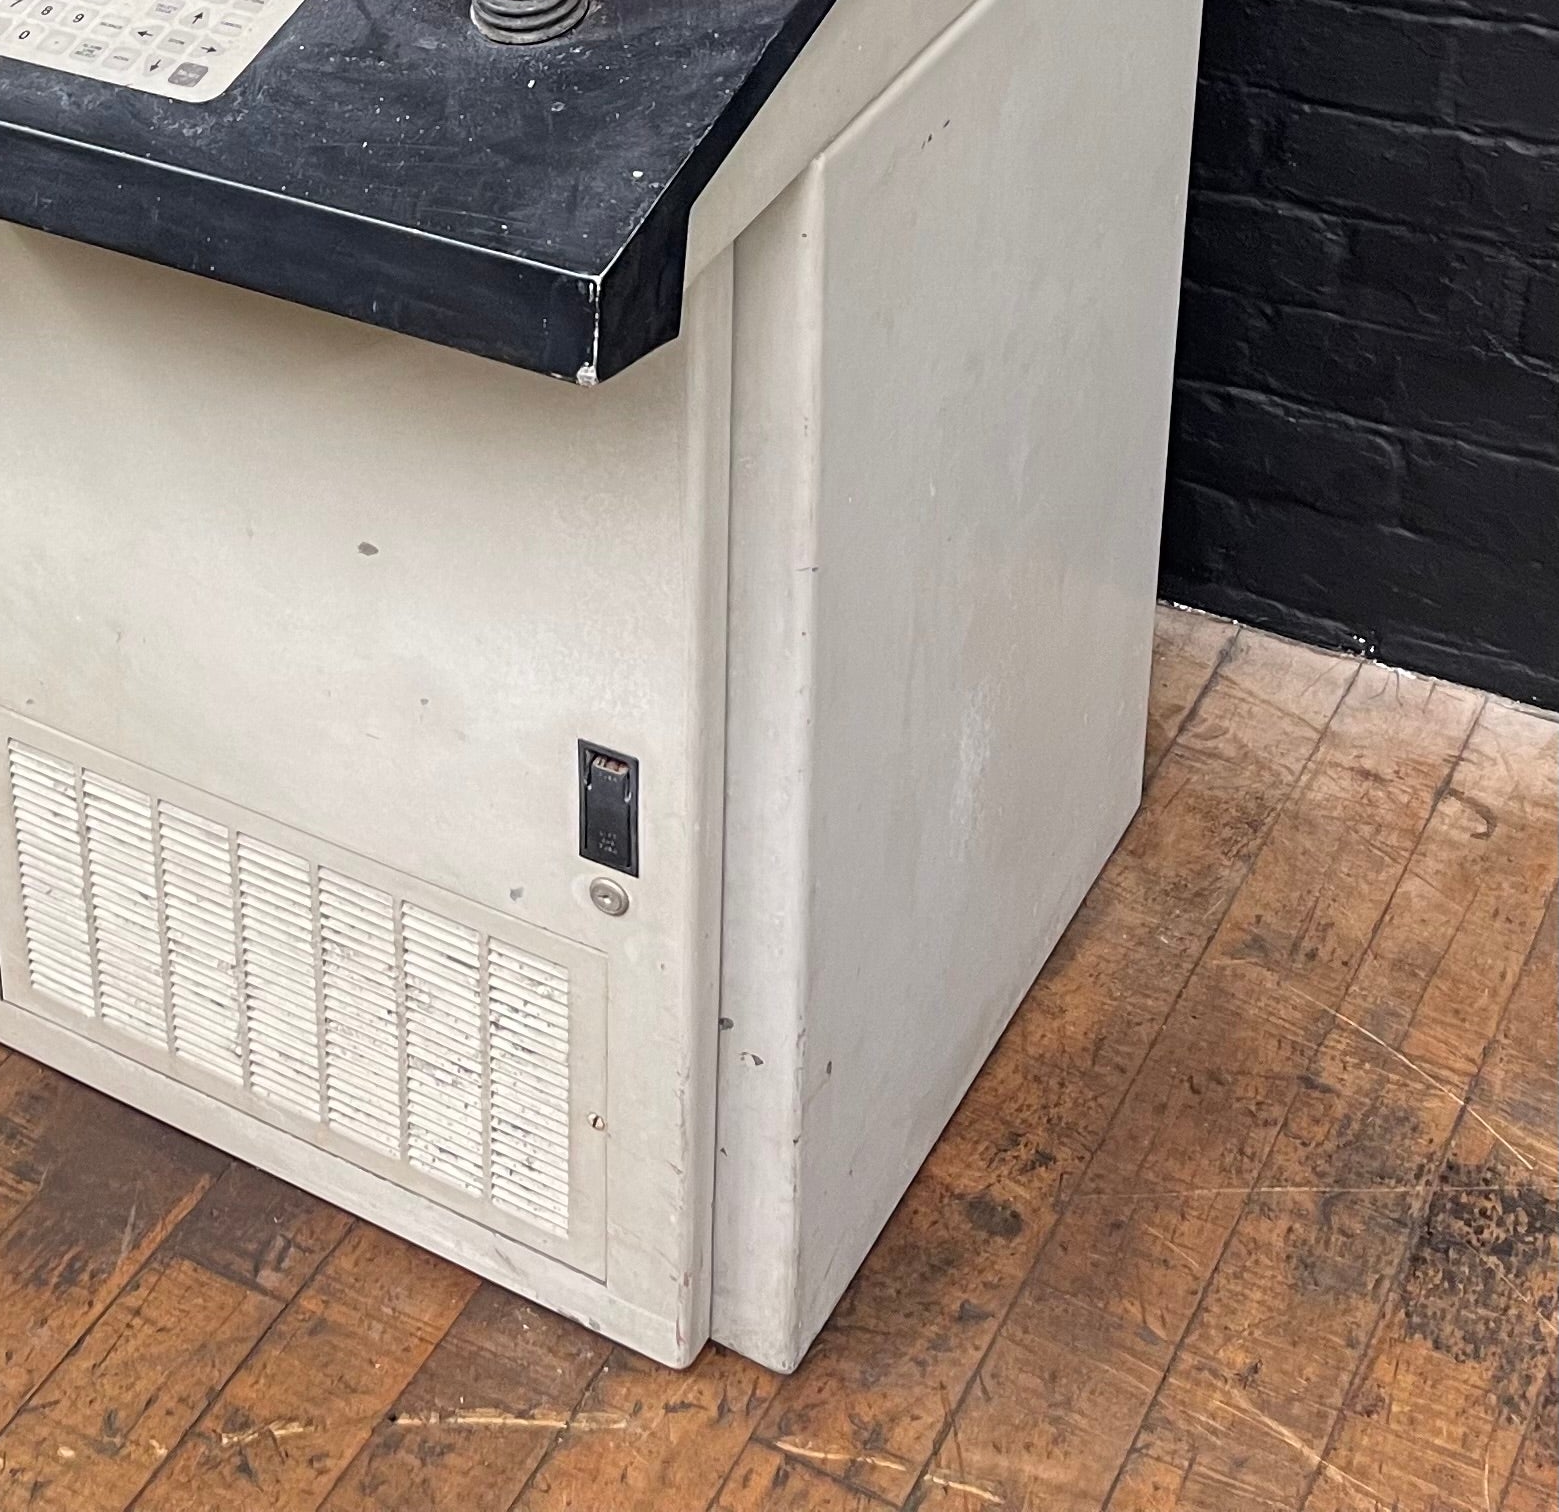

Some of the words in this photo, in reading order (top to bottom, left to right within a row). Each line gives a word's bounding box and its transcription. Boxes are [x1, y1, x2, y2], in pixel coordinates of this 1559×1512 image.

[40, 5, 53, 16] 8
[73, 13, 84, 23] 9
[18, 30, 30, 40] 0
